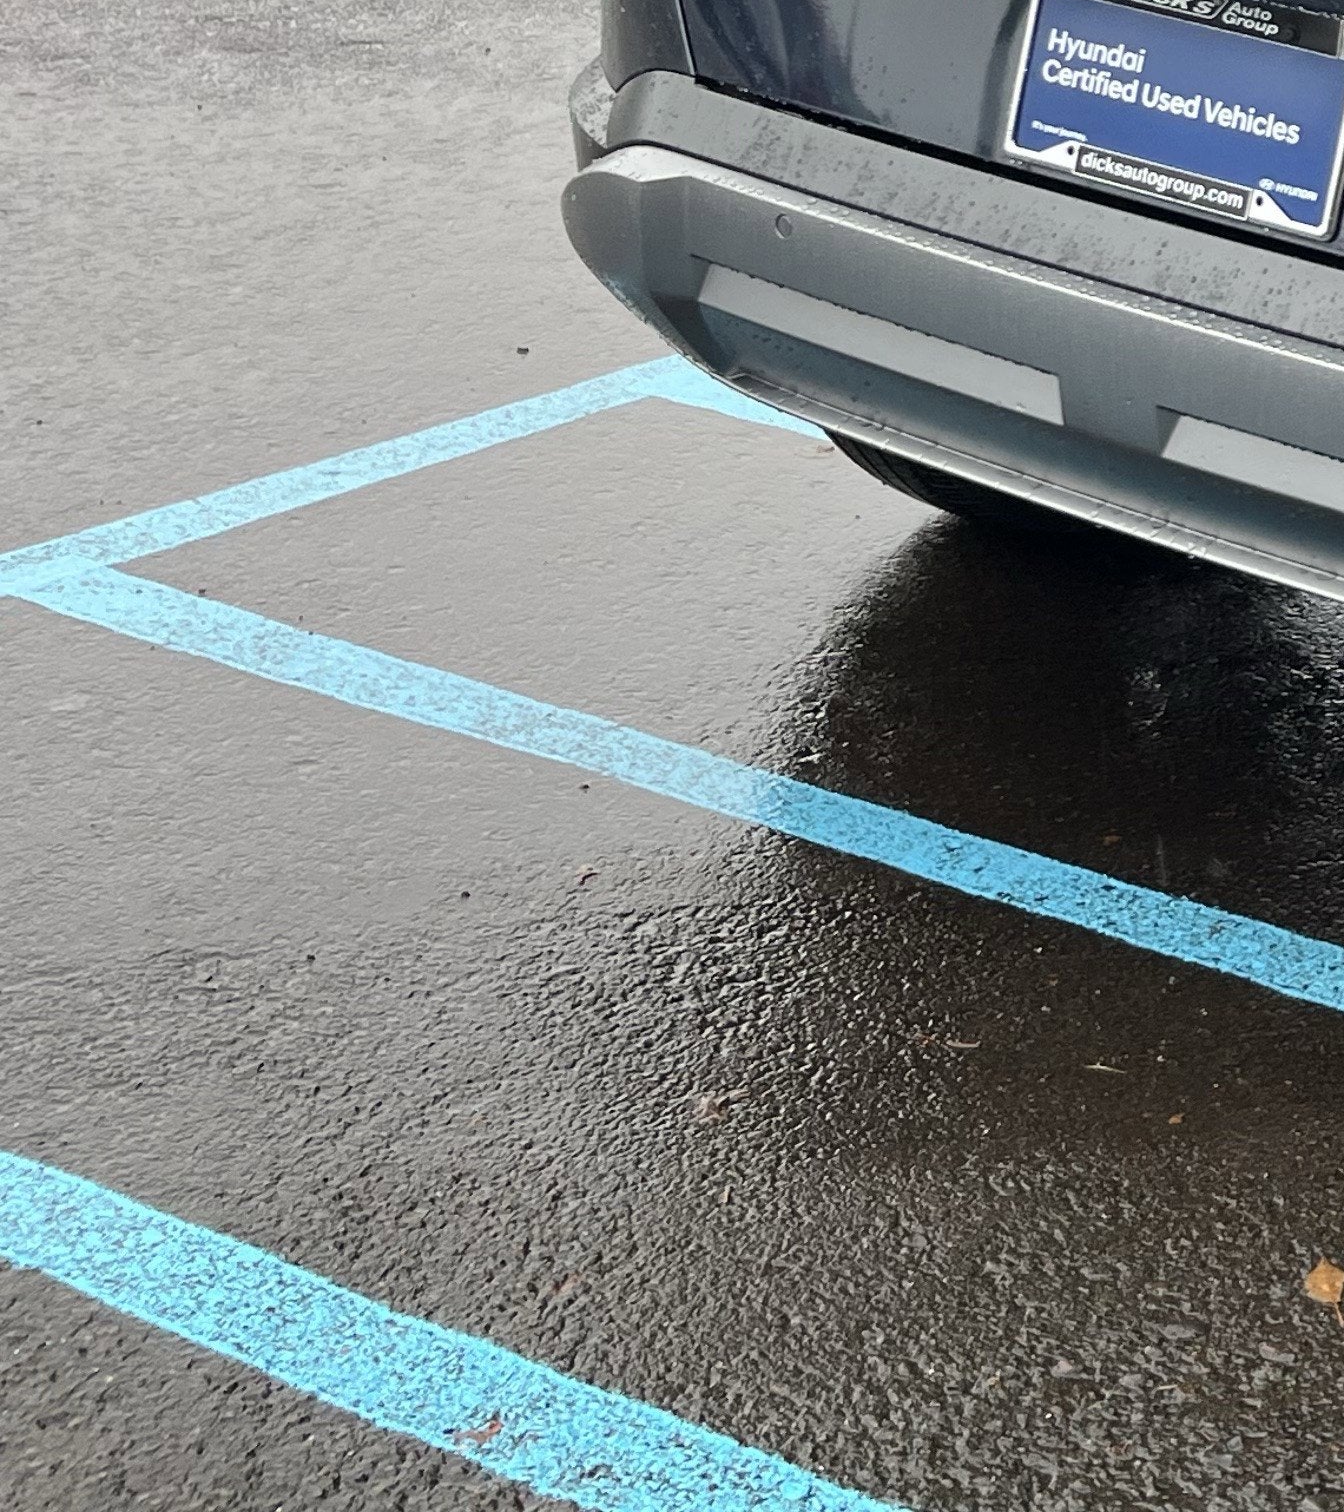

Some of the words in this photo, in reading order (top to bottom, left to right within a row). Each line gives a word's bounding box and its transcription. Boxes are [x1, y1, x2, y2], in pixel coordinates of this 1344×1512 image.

[1222, 12, 1279, 36] Group
[1228, 1, 1273, 22] Auto
[1046, 29, 1147, 74] Hyundai
[1042, 59, 1138, 104] Certified
[1142, 83, 1200, 120] Used
[1203, 97, 1300, 146] Vehicles
[1080, 151, 1244, 210] dicksautogroup.com
